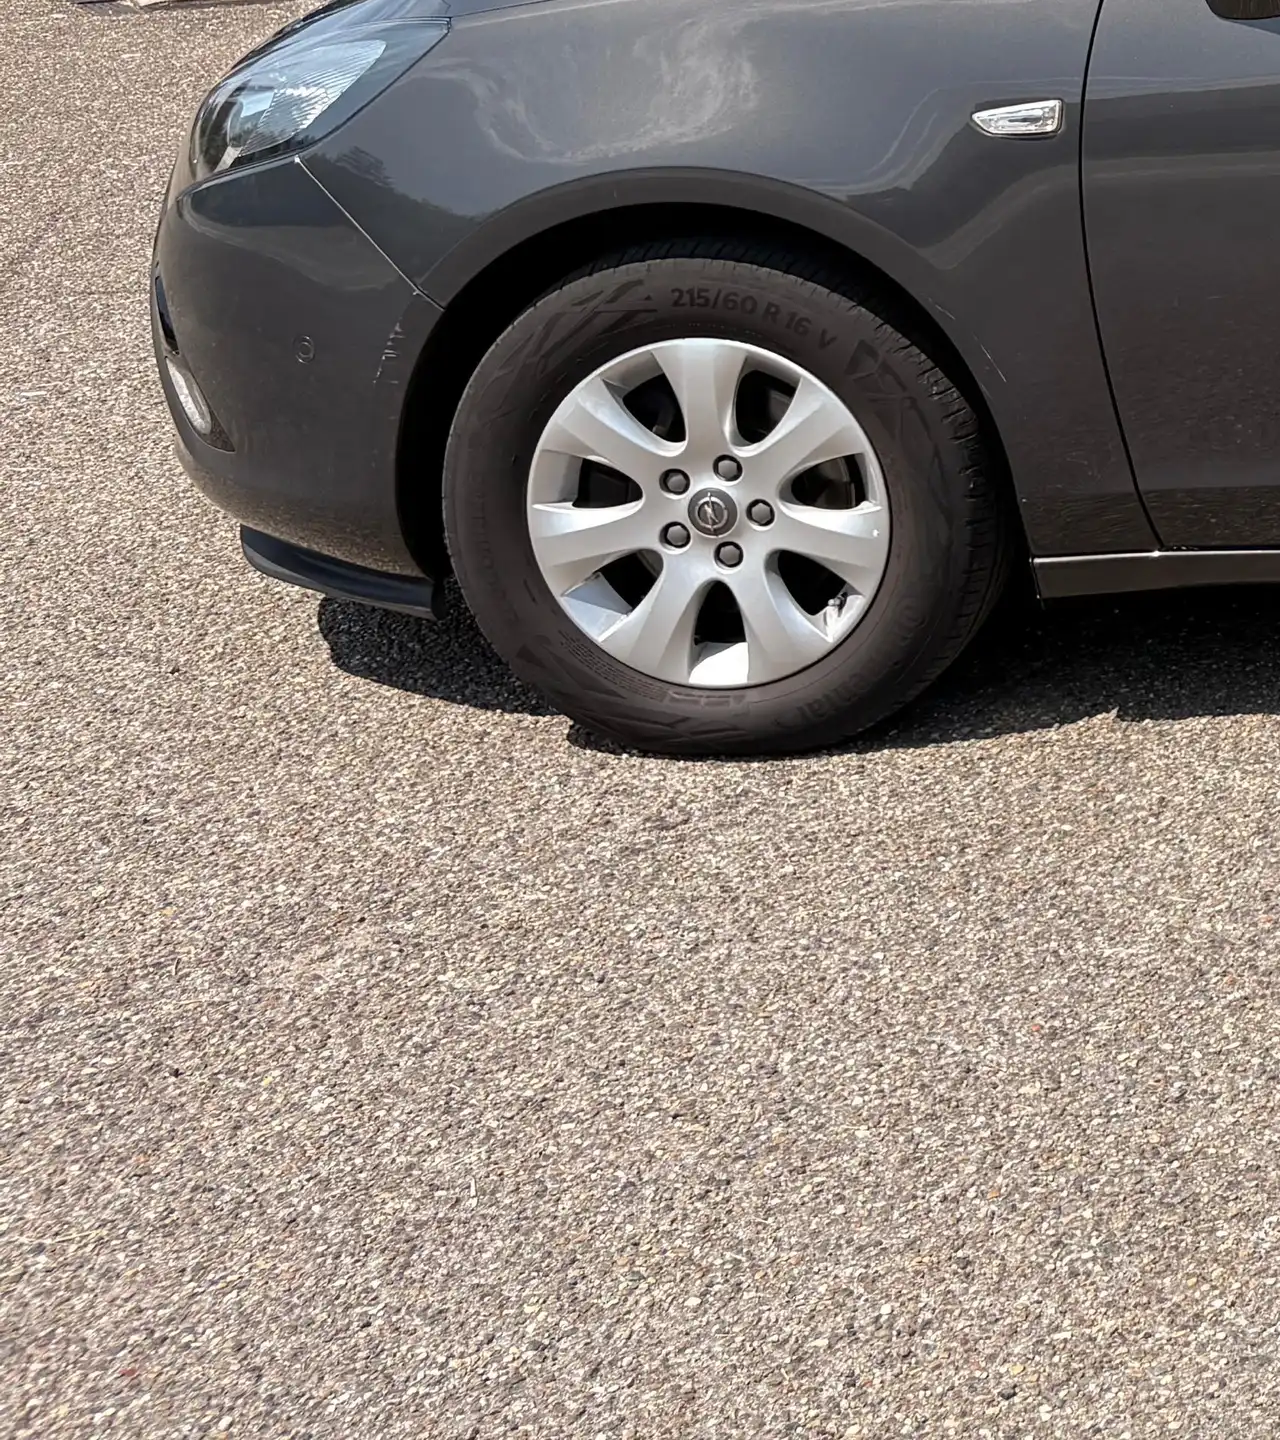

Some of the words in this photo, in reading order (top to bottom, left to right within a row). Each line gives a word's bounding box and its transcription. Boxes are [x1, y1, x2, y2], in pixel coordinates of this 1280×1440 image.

[669, 286, 758, 319] 215/60
[762, 302, 781, 327] R
[784, 308, 812, 338] 16
